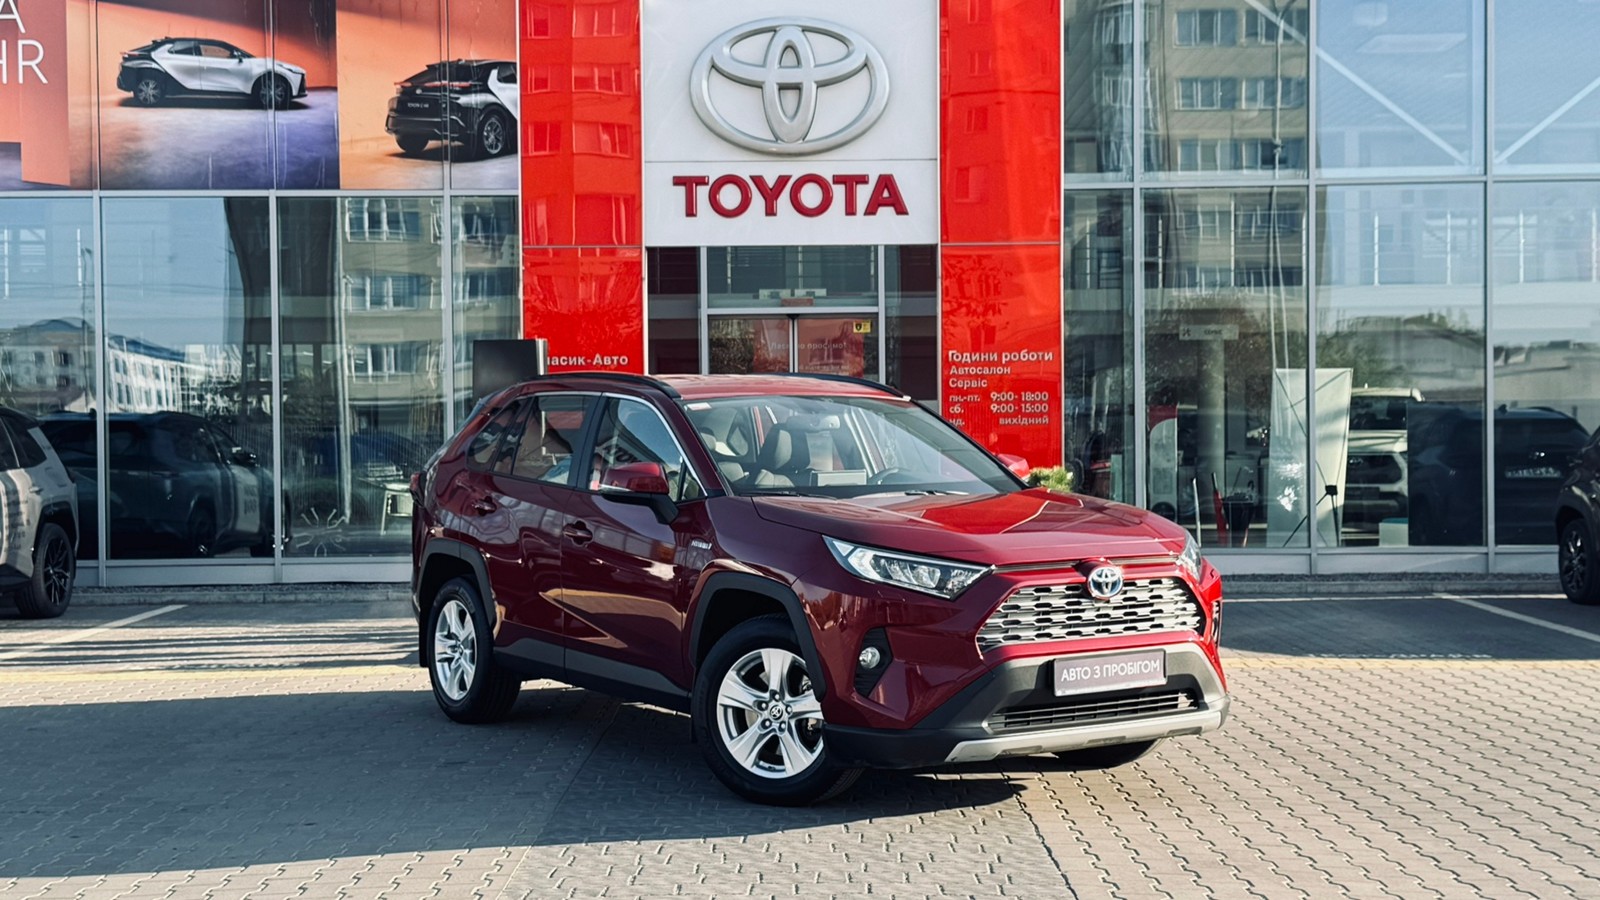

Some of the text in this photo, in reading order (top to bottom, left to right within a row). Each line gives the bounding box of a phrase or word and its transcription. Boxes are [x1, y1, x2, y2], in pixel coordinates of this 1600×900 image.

[673, 173, 909, 218] TOYOTA
[547, 353, 628, 366] асик-Авто
[948, 349, 1053, 364] Години роботи
[949, 365, 1011, 375] Автосалон
[949, 378, 988, 390] Сервіс
[949, 404, 964, 414] сб.
[999, 415, 1049, 425] вихідний
[1061, 666, 1091, 682] АВТО
[1103, 659, 1160, 678] ПРОБІГОМ
